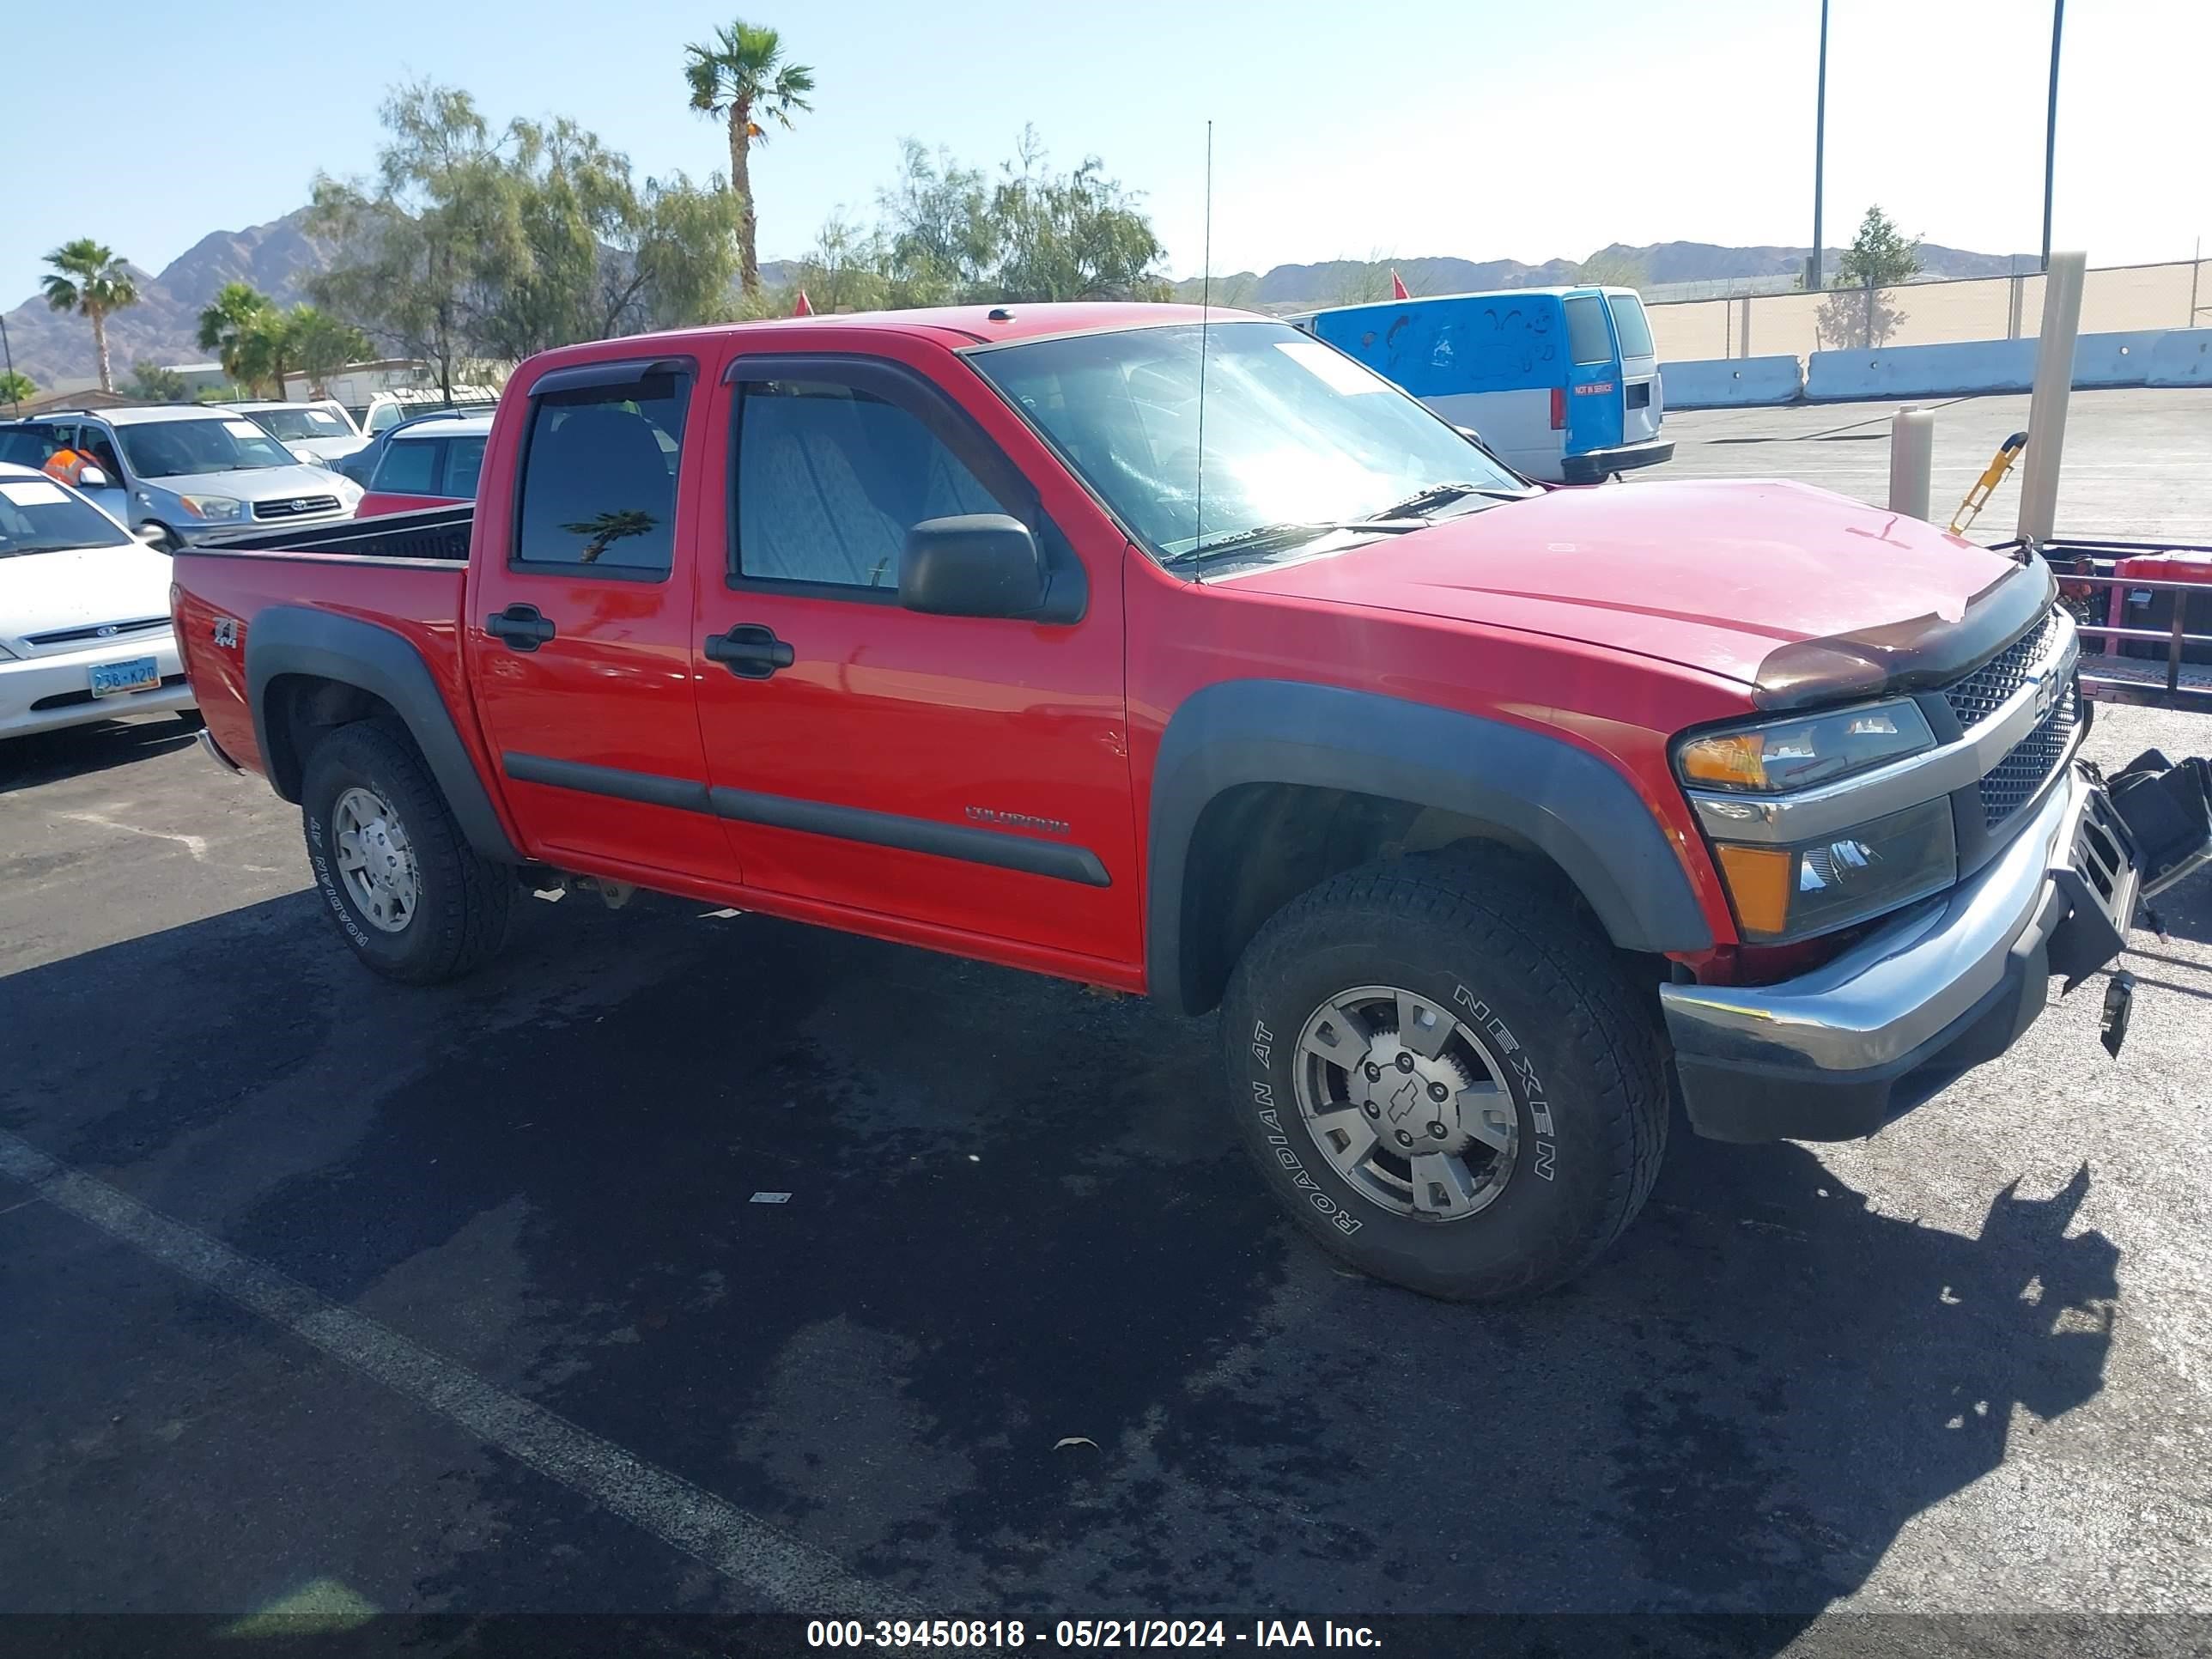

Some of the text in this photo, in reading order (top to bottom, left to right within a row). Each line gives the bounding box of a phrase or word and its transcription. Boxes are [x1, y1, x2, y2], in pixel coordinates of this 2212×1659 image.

[1575, 385, 1587, 394] NOT
[315, 856, 369, 947] ROADIAN
[1252, 1019, 1364, 1236] ROADIAN AT
[1453, 984, 1556, 1182] NEXEN
